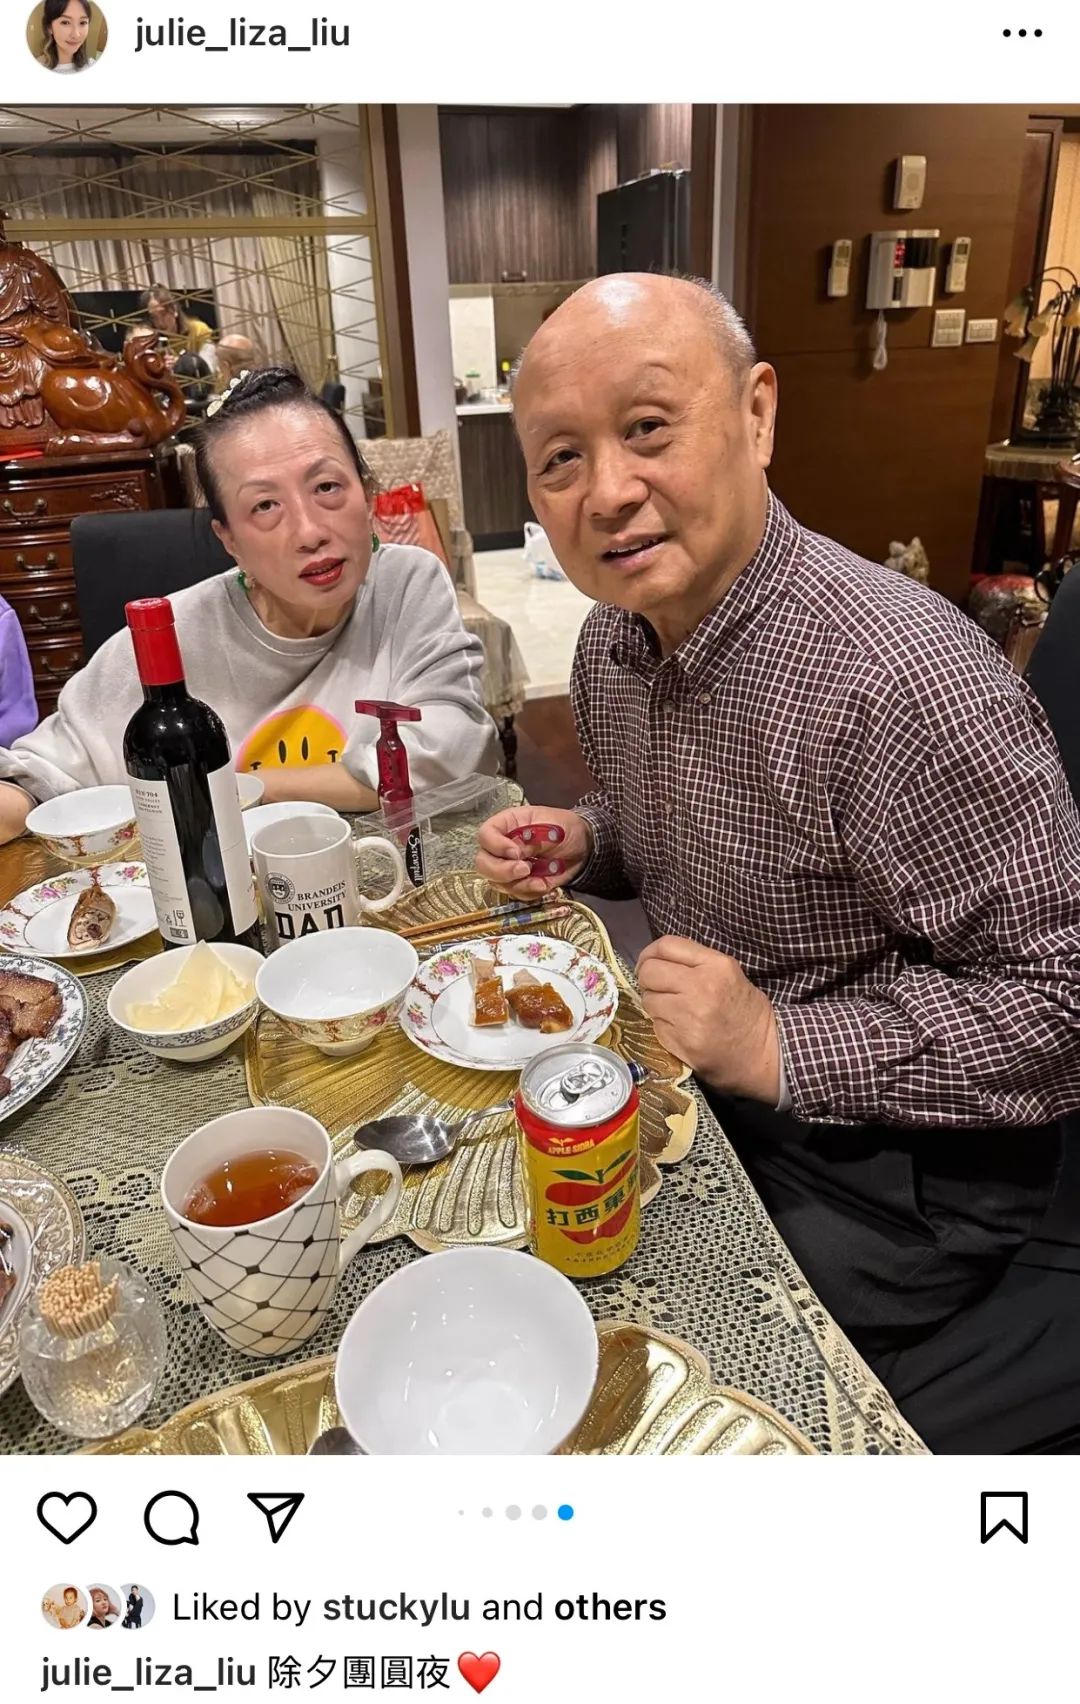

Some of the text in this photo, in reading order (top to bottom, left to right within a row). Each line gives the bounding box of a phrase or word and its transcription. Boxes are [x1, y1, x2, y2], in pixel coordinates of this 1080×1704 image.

[297, 880, 346, 901] BRANDEIS
[287, 891, 347, 912] UNIVERSITY
[274, 904, 345, 940] DAD
[548, 1146, 571, 1154] APPLE
